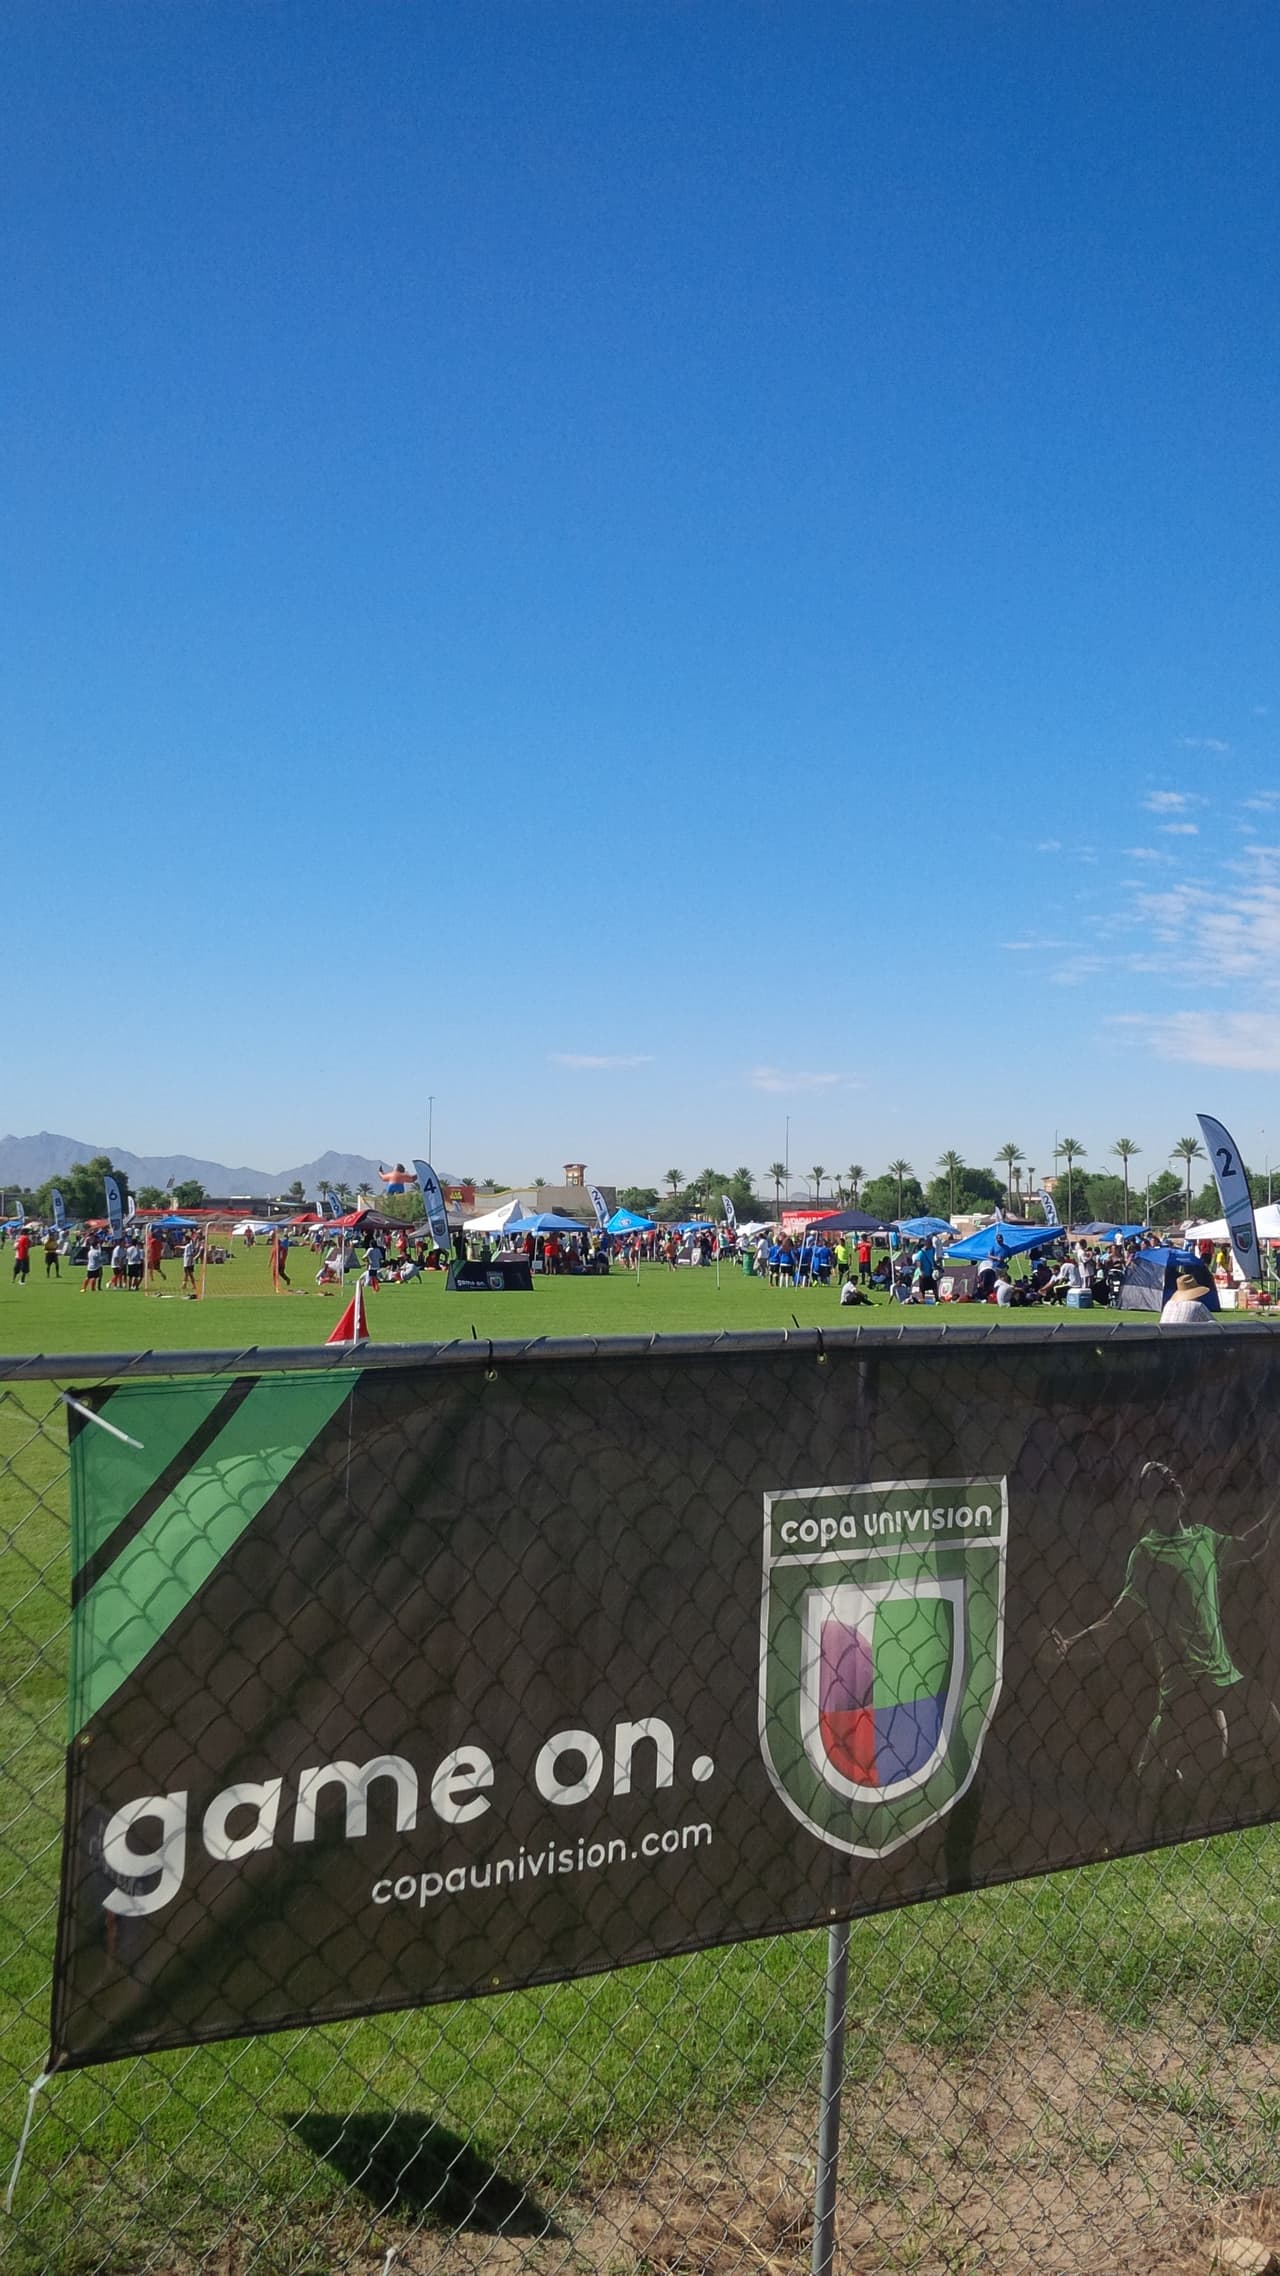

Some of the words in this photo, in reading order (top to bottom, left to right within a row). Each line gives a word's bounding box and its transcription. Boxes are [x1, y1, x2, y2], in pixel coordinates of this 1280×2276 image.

[1216, 1147, 1237, 1177] 2
[108, 1189, 118, 1201] 6
[423, 1178, 437, 1194] 4
[591, 1190, 603, 1211] 21
[725, 1199, 732, 1214] 20
[1043, 1195, 1054, 1214] 22
[781, 1515, 857, 1547] copa
[863, 1504, 993, 1537] univision
[102, 1745, 494, 1917] game
[535, 1716, 714, 1806] on.
[371, 1821, 713, 1908] copaunivision.com
